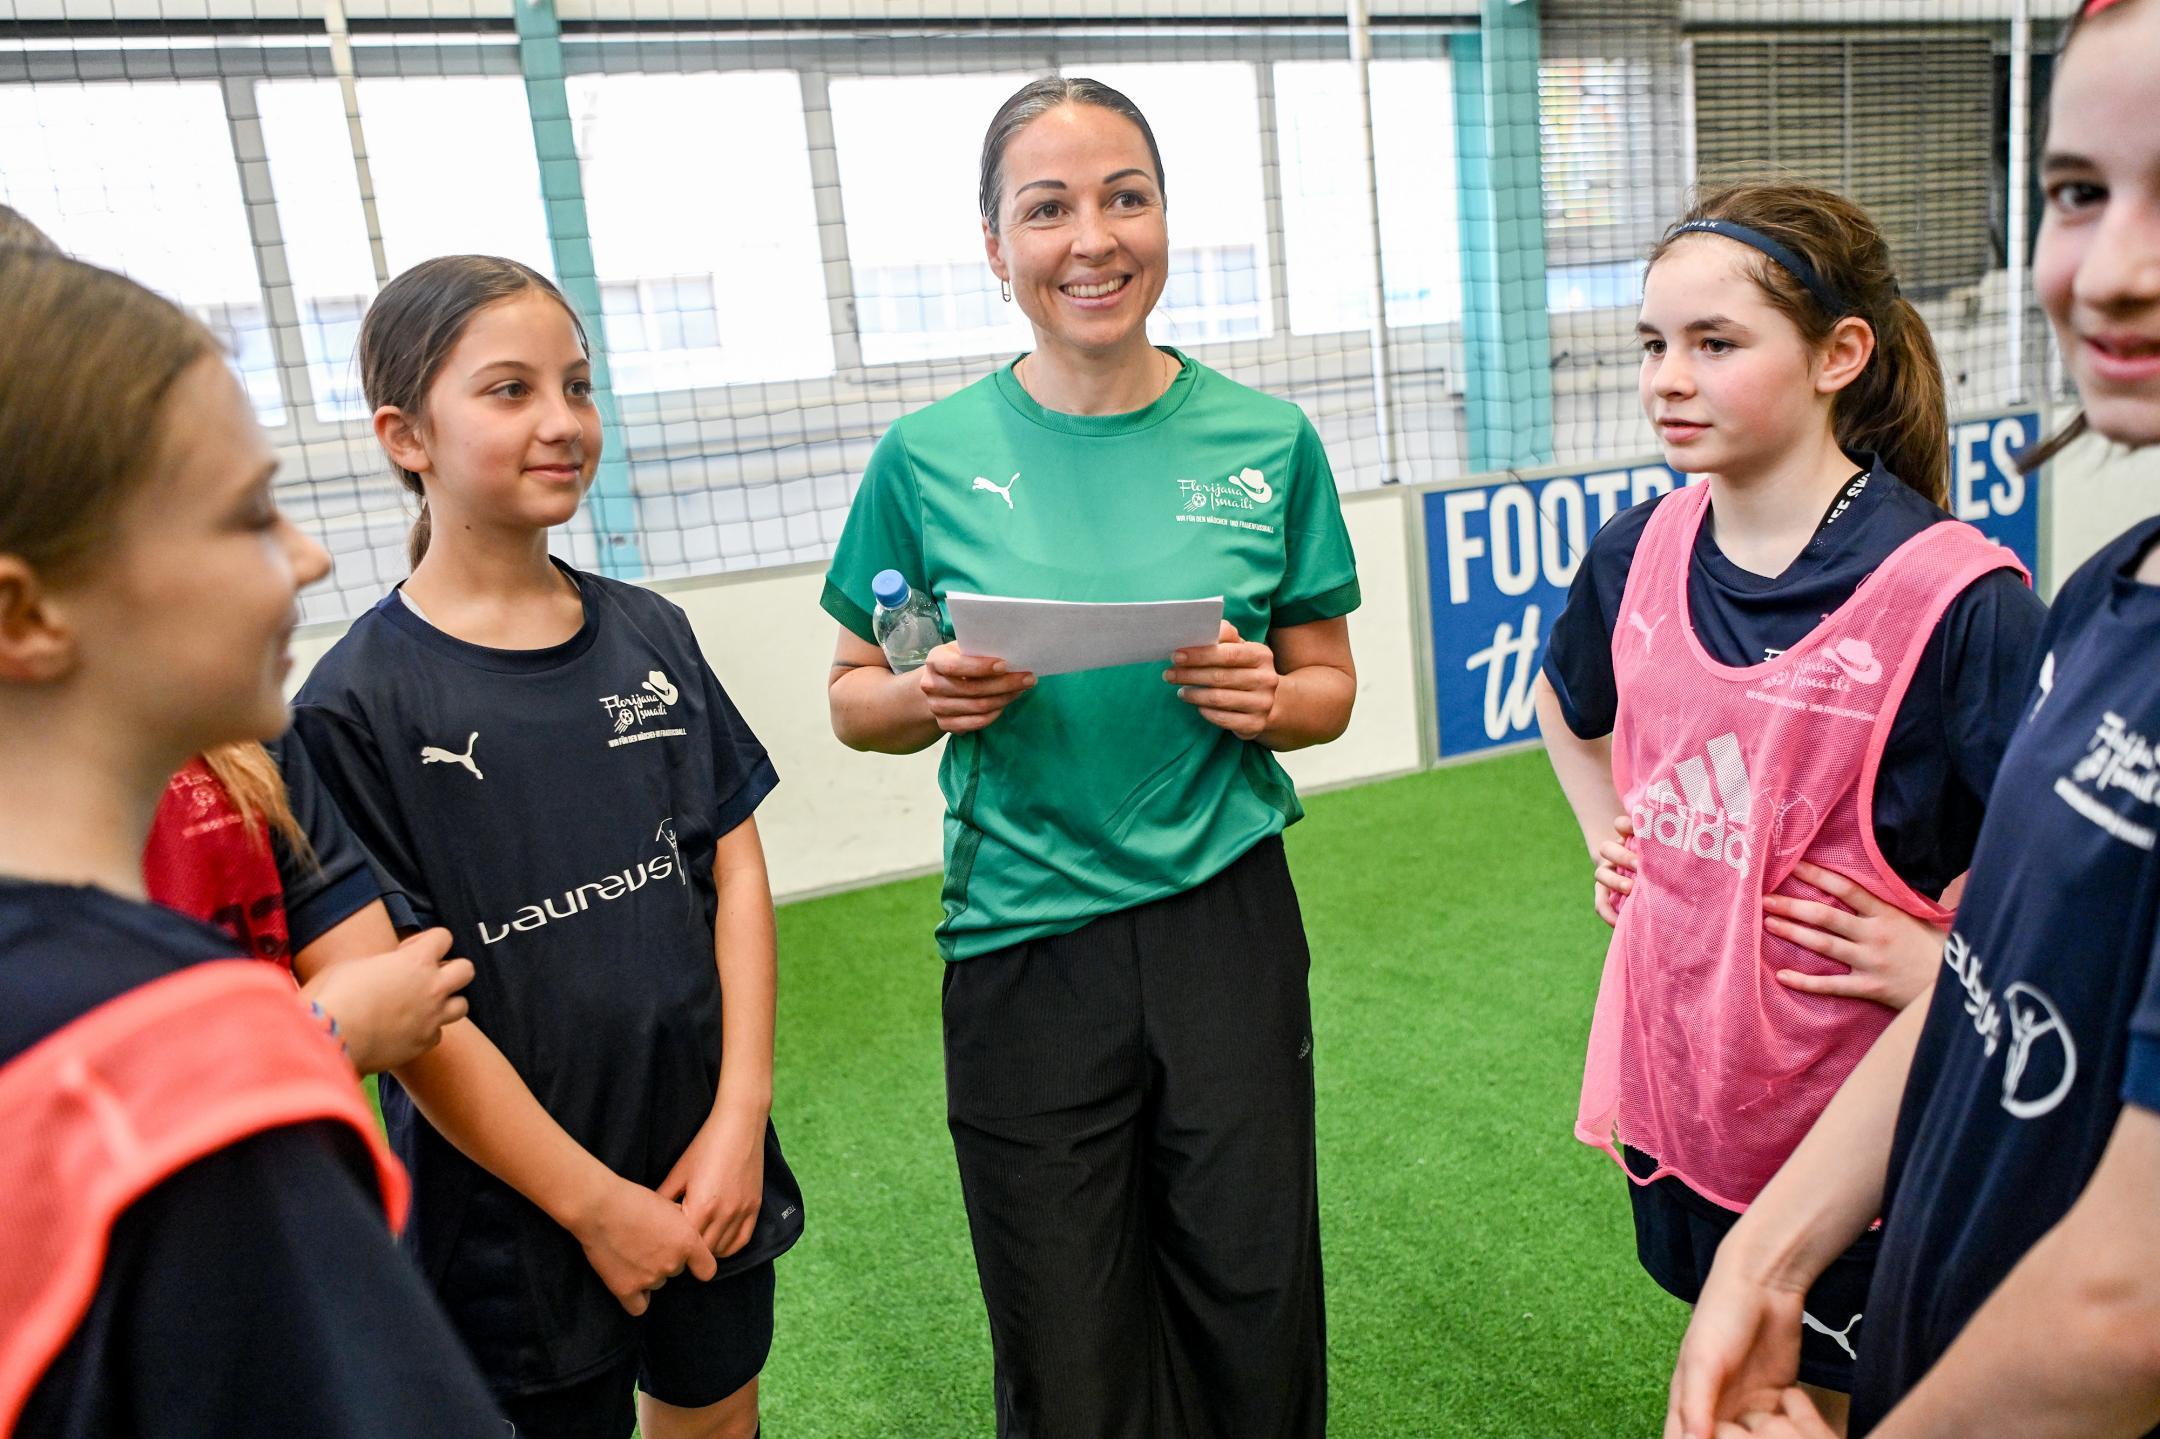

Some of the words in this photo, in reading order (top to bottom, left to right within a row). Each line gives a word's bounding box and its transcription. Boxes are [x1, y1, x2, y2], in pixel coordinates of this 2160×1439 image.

[1177, 479, 1244, 498] Florijana
[1210, 493, 1254, 511] Ismaili
[1444, 467, 1712, 605] FOOT
[1466, 604, 1544, 740] th
[598, 694, 660, 718] Florijana
[634, 702, 668, 726] Ismaili
[477, 855, 672, 945] Laureus
